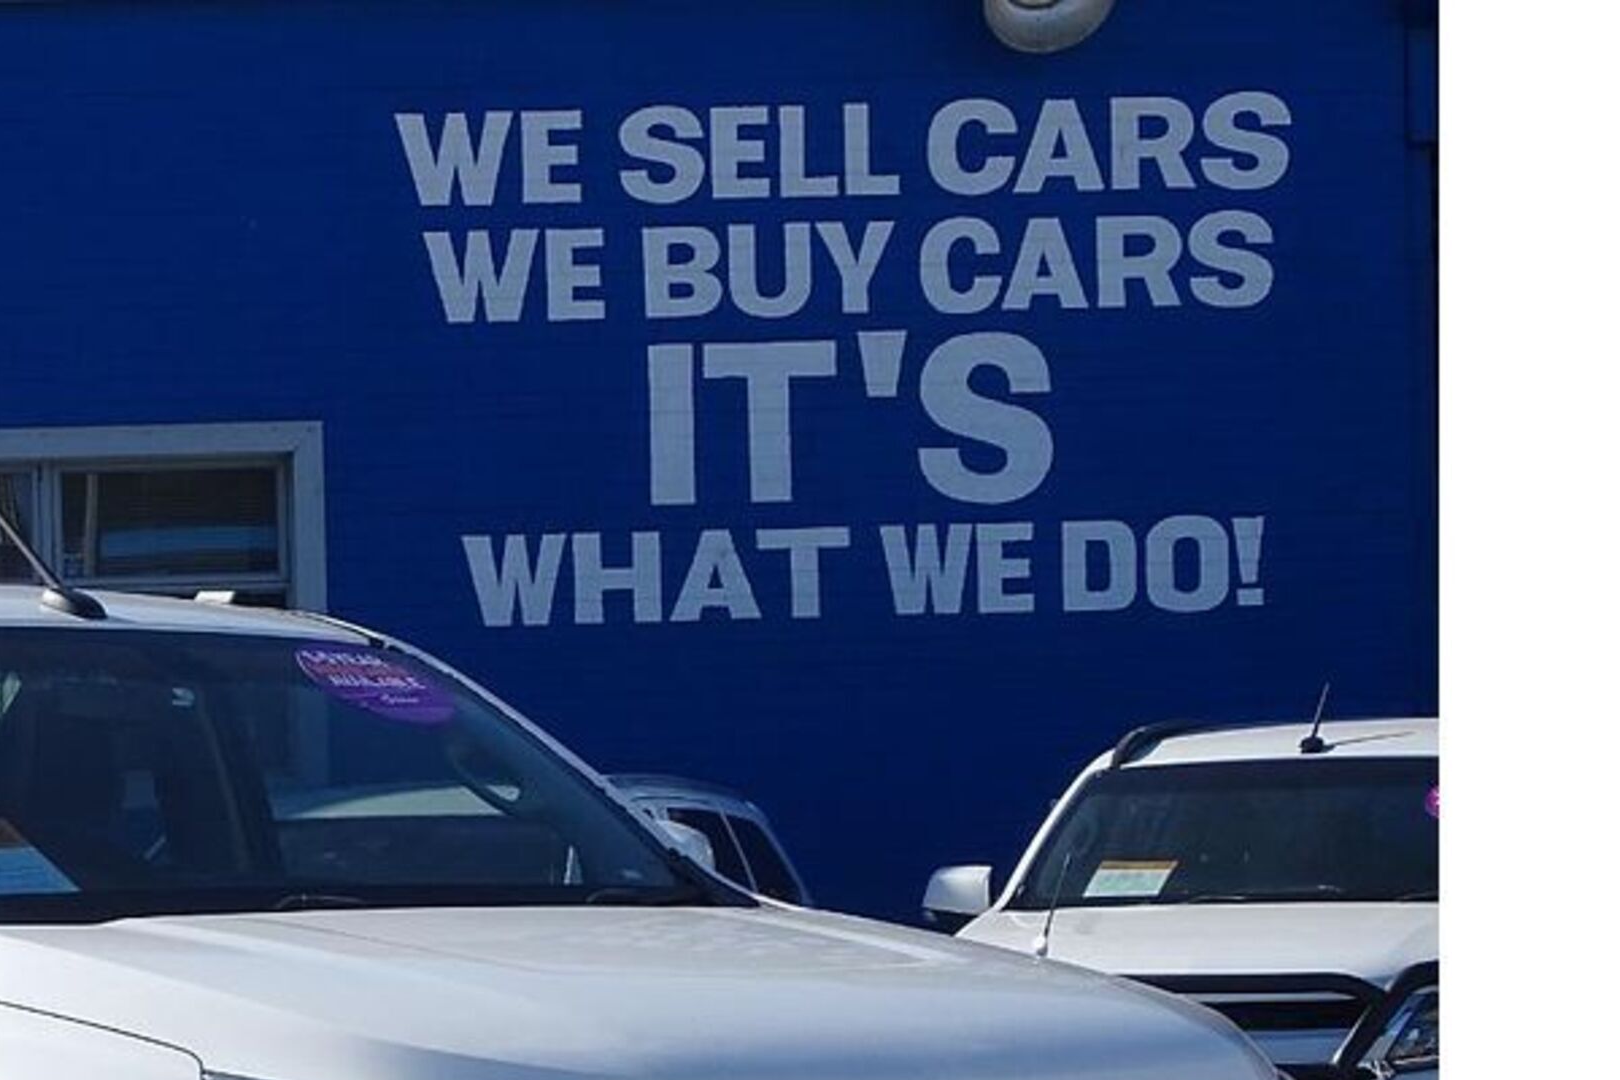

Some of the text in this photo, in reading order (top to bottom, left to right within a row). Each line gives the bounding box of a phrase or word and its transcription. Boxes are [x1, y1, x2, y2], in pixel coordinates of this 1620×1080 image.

[395, 92, 1291, 205] WE SELL CARS
[423, 210, 1273, 322] WE BUY CARS
[648, 330, 1053, 504] IT'S
[462, 516, 1263, 626] WHAT WE DO!
